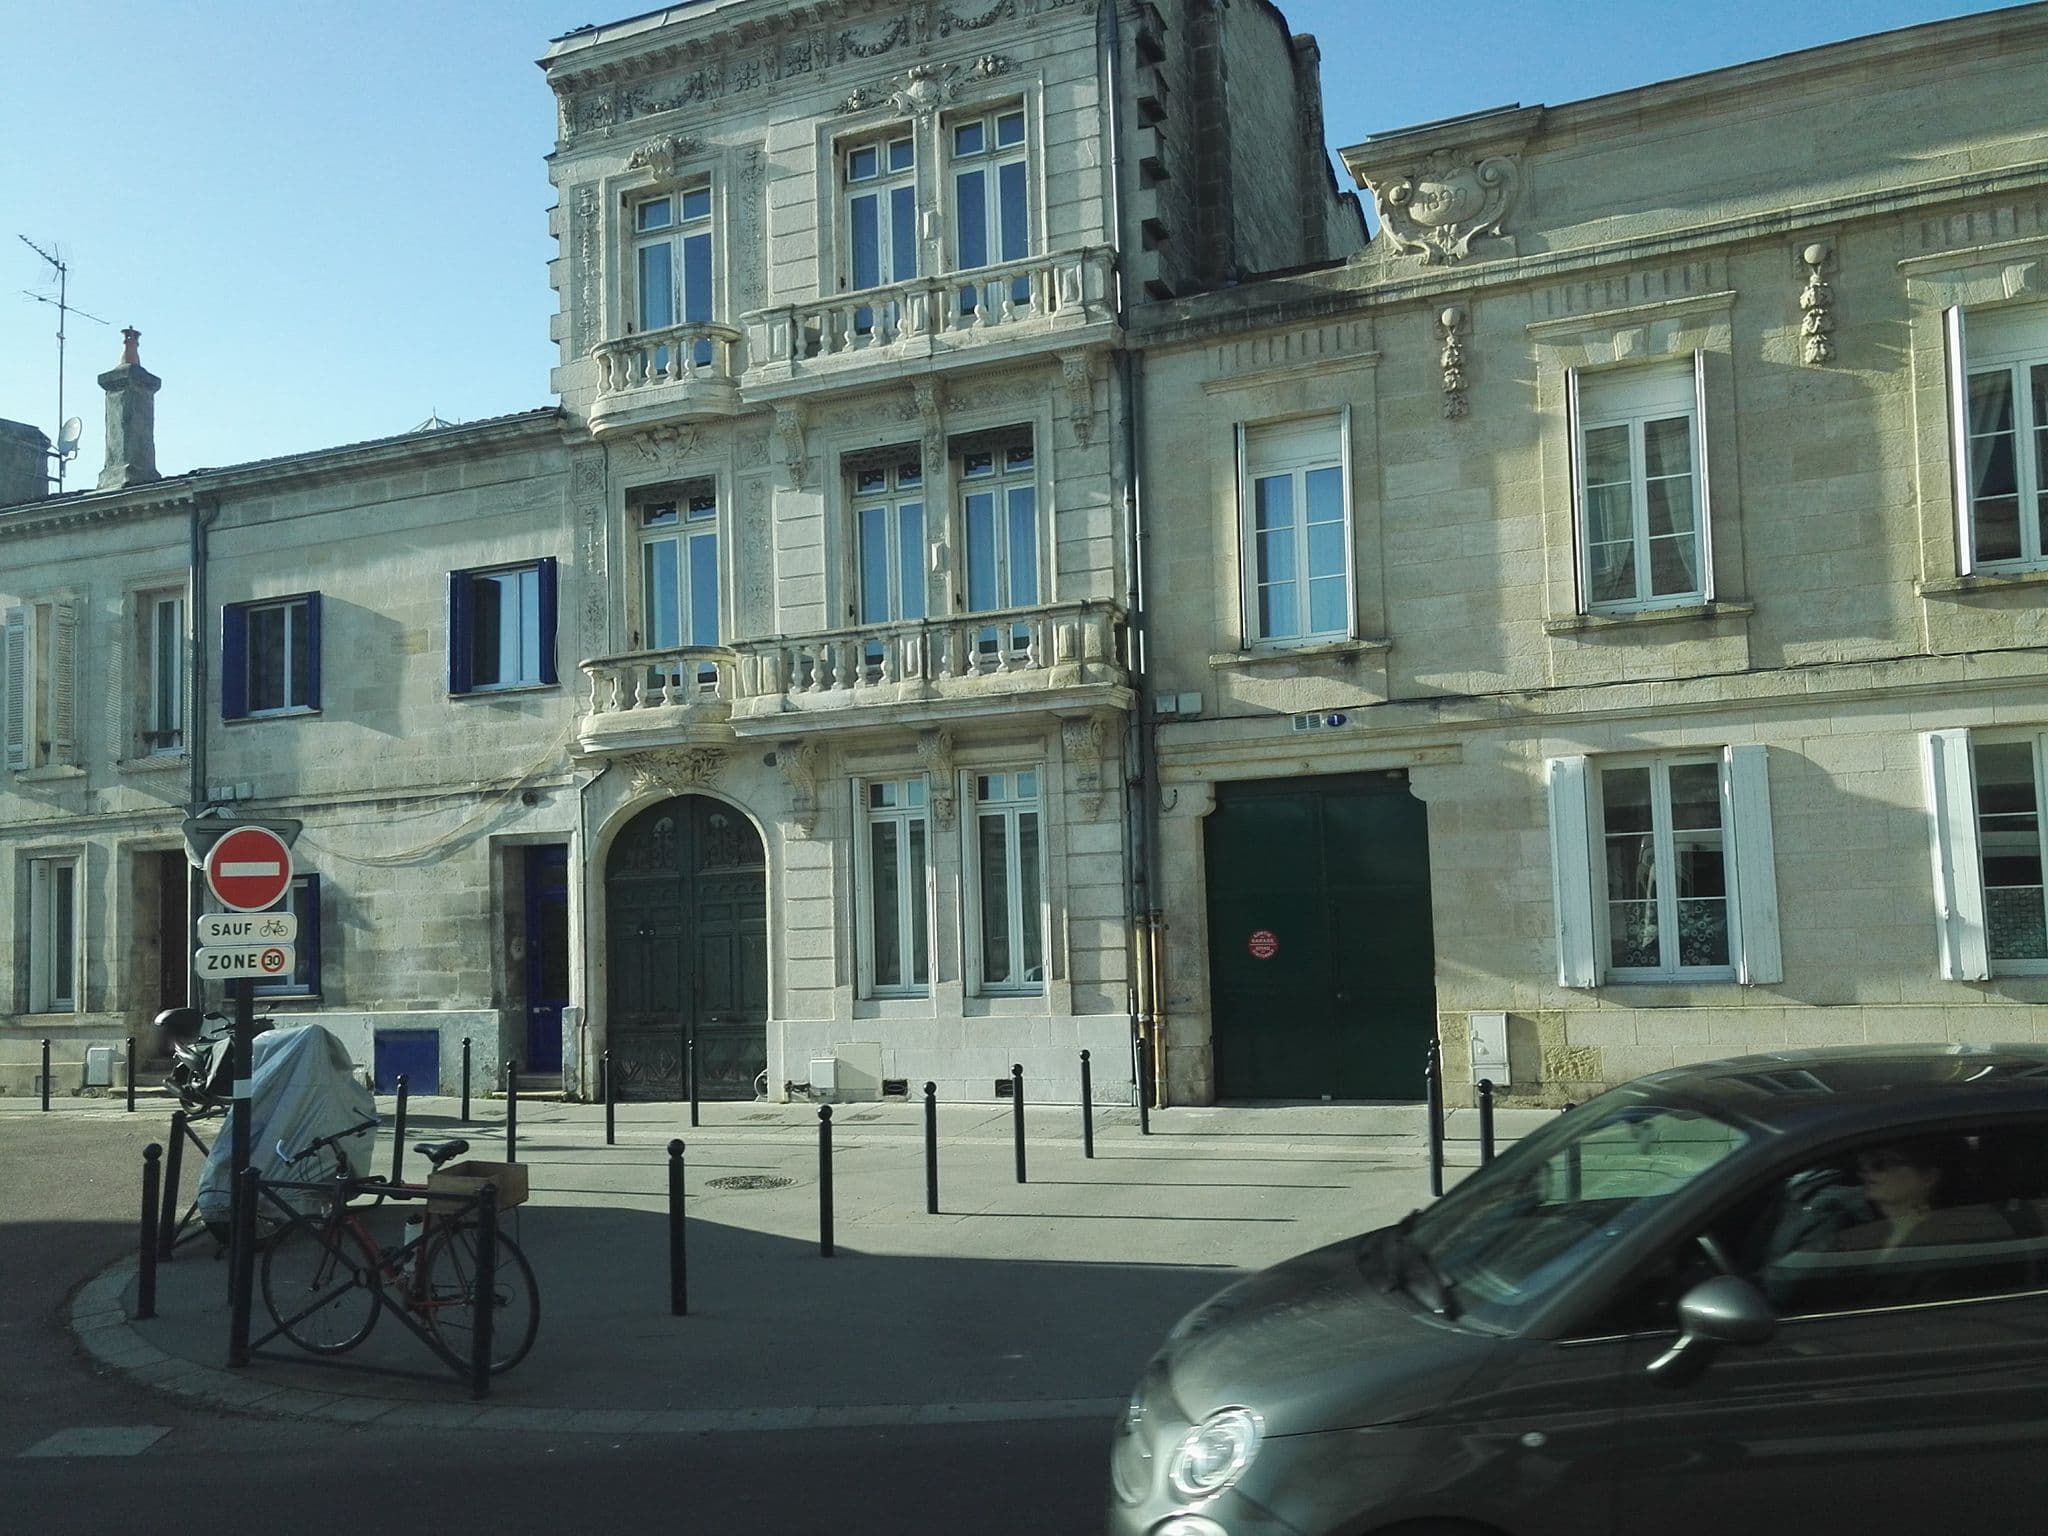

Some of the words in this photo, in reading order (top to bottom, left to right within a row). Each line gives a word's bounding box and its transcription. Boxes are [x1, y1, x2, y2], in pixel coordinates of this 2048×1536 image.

[211, 923, 252, 936] SAUF
[208, 954, 257, 970] ZONE
[266, 955, 281, 966] 30
